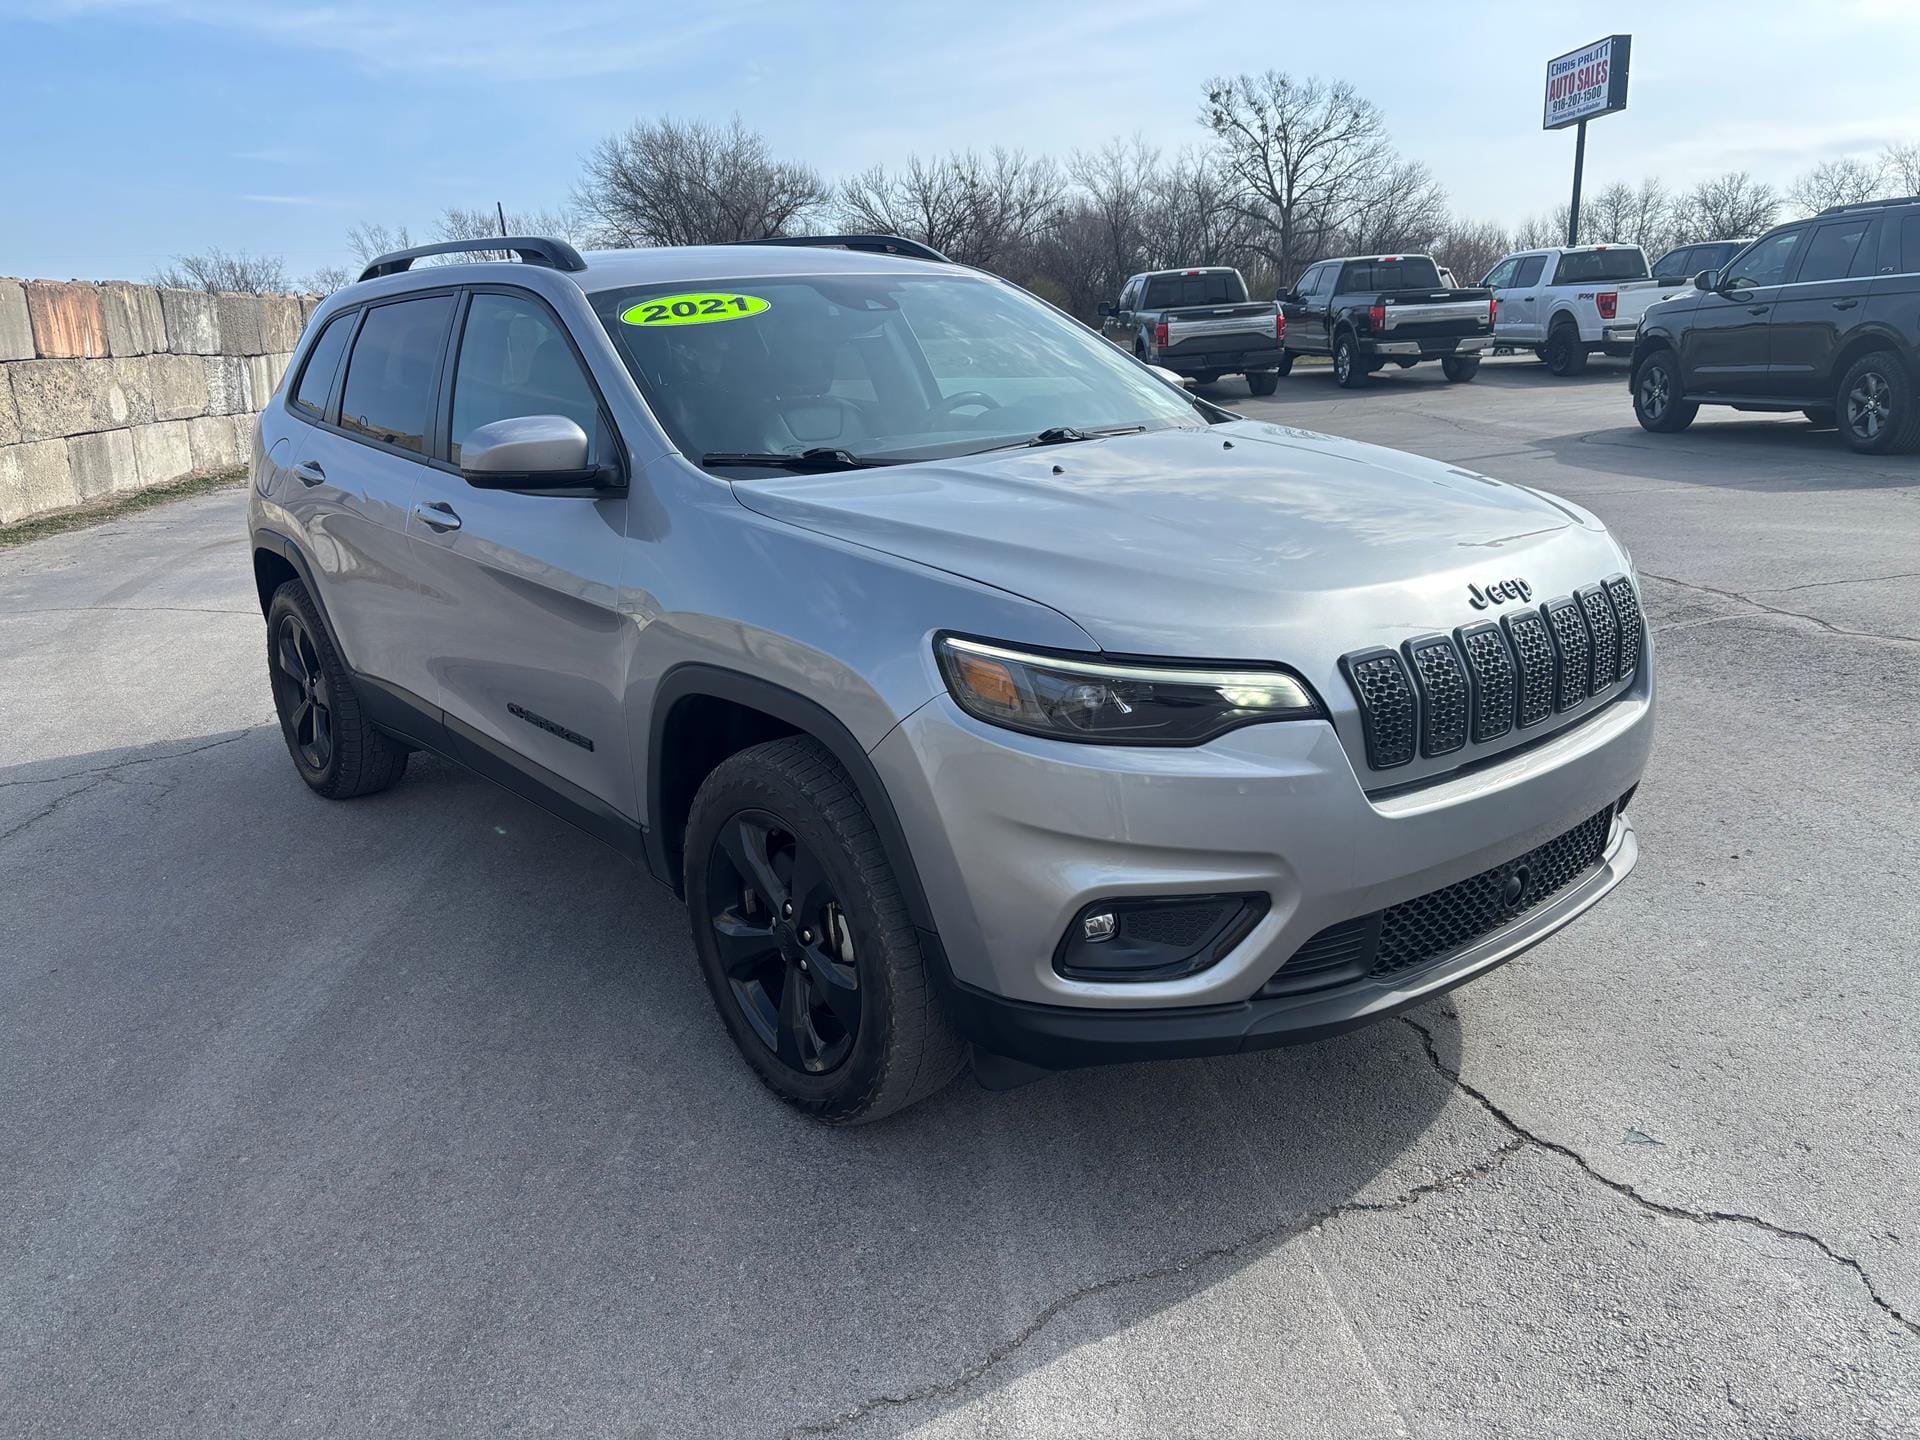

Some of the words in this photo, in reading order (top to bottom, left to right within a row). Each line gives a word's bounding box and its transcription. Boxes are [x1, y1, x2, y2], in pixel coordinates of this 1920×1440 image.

[1551, 59, 1576, 77] CHRIS
[1577, 41, 1610, 67] PRUITT
[1549, 71, 1575, 102] AUTO
[1577, 59, 1608, 92] SALES
[1552, 85, 1602, 113] 918-207-1500
[642, 296, 749, 323] 2021
[1467, 577, 1532, 611] Jeep
